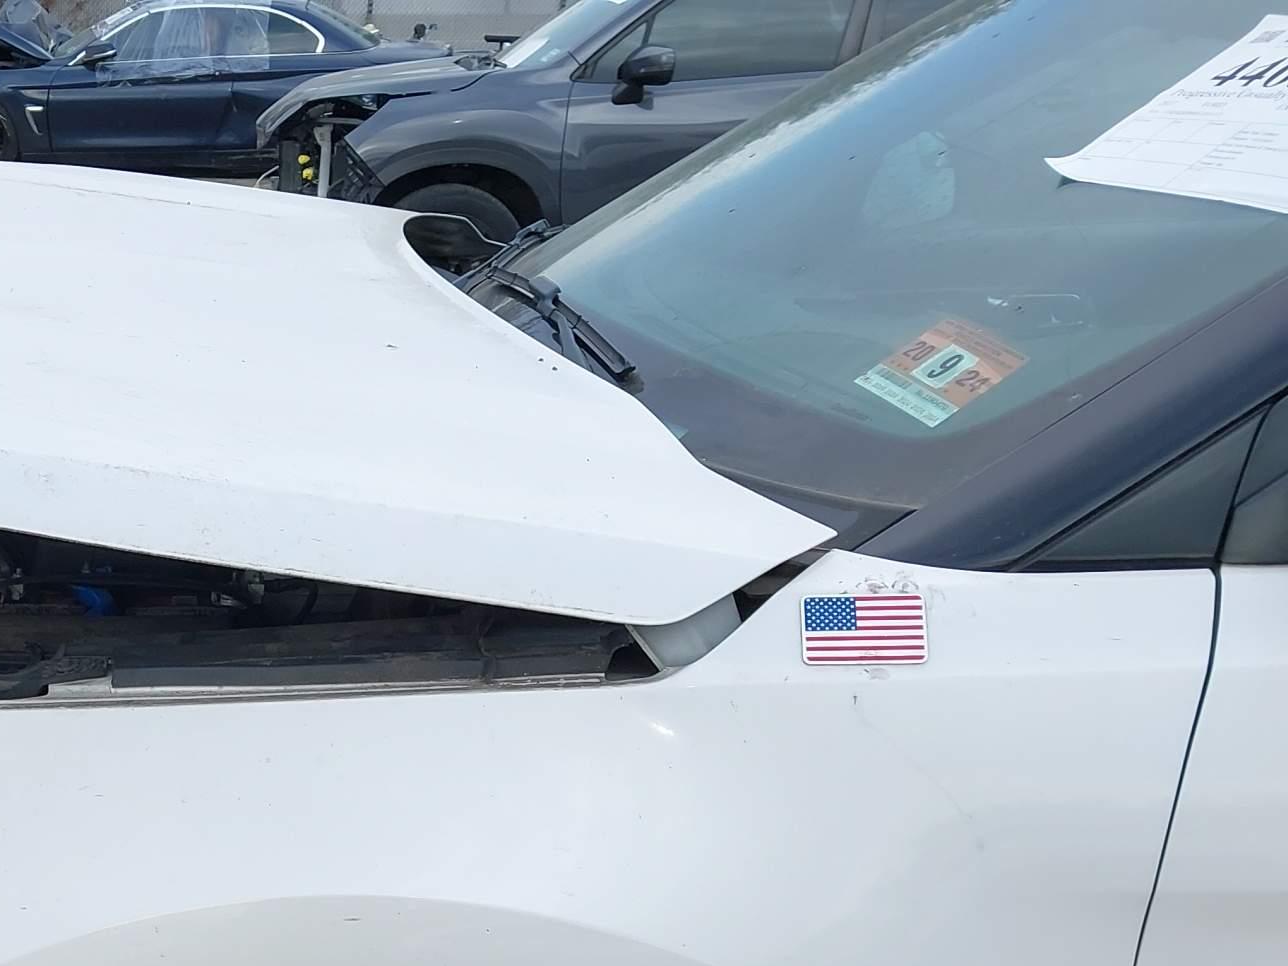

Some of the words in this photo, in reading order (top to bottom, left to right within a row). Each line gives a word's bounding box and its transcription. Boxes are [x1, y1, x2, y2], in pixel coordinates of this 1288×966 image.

[902, 341, 936, 362] 20
[927, 354, 965, 379] 9
[955, 370, 990, 393] 24
